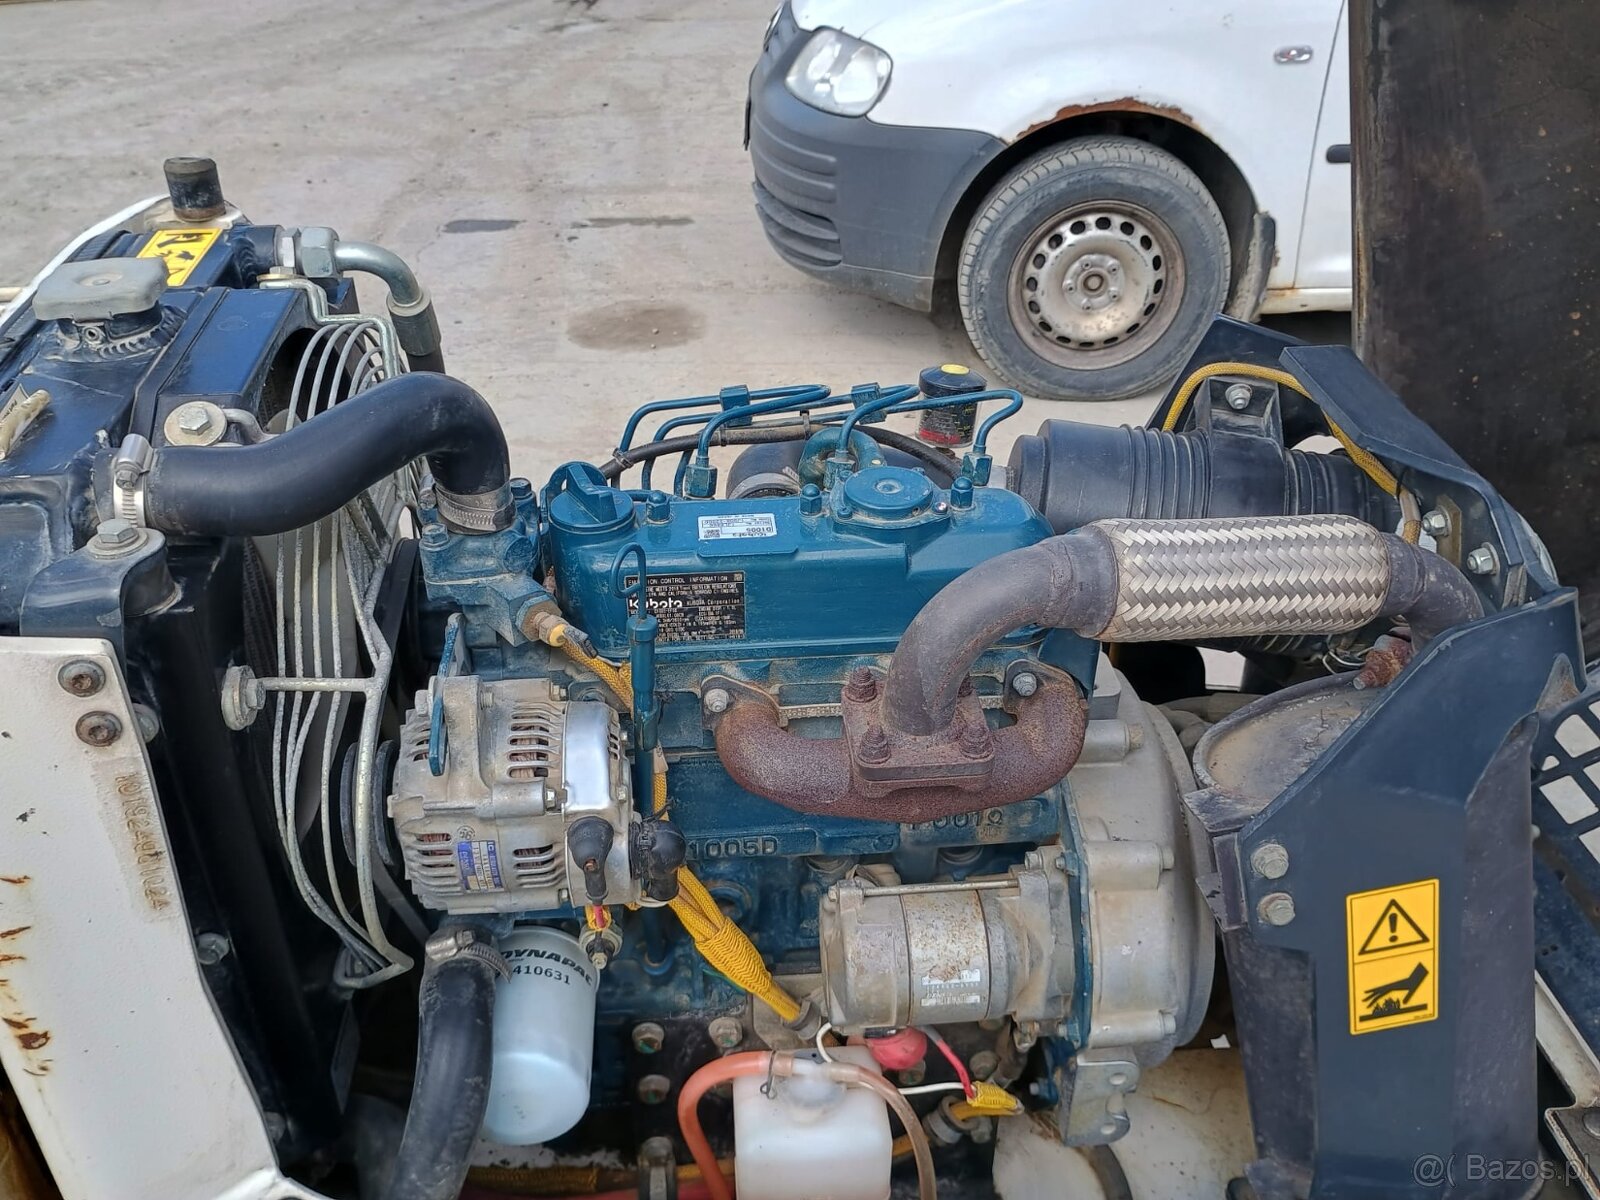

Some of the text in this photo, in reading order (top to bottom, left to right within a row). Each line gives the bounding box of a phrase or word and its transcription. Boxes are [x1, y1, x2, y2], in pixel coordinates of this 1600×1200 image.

[660, 577, 686, 585] CONTROL
[689, 575, 728, 583] INFORMATION
[501, 948, 593, 986] DYNAPAC
[512, 964, 571, 986] 410631
